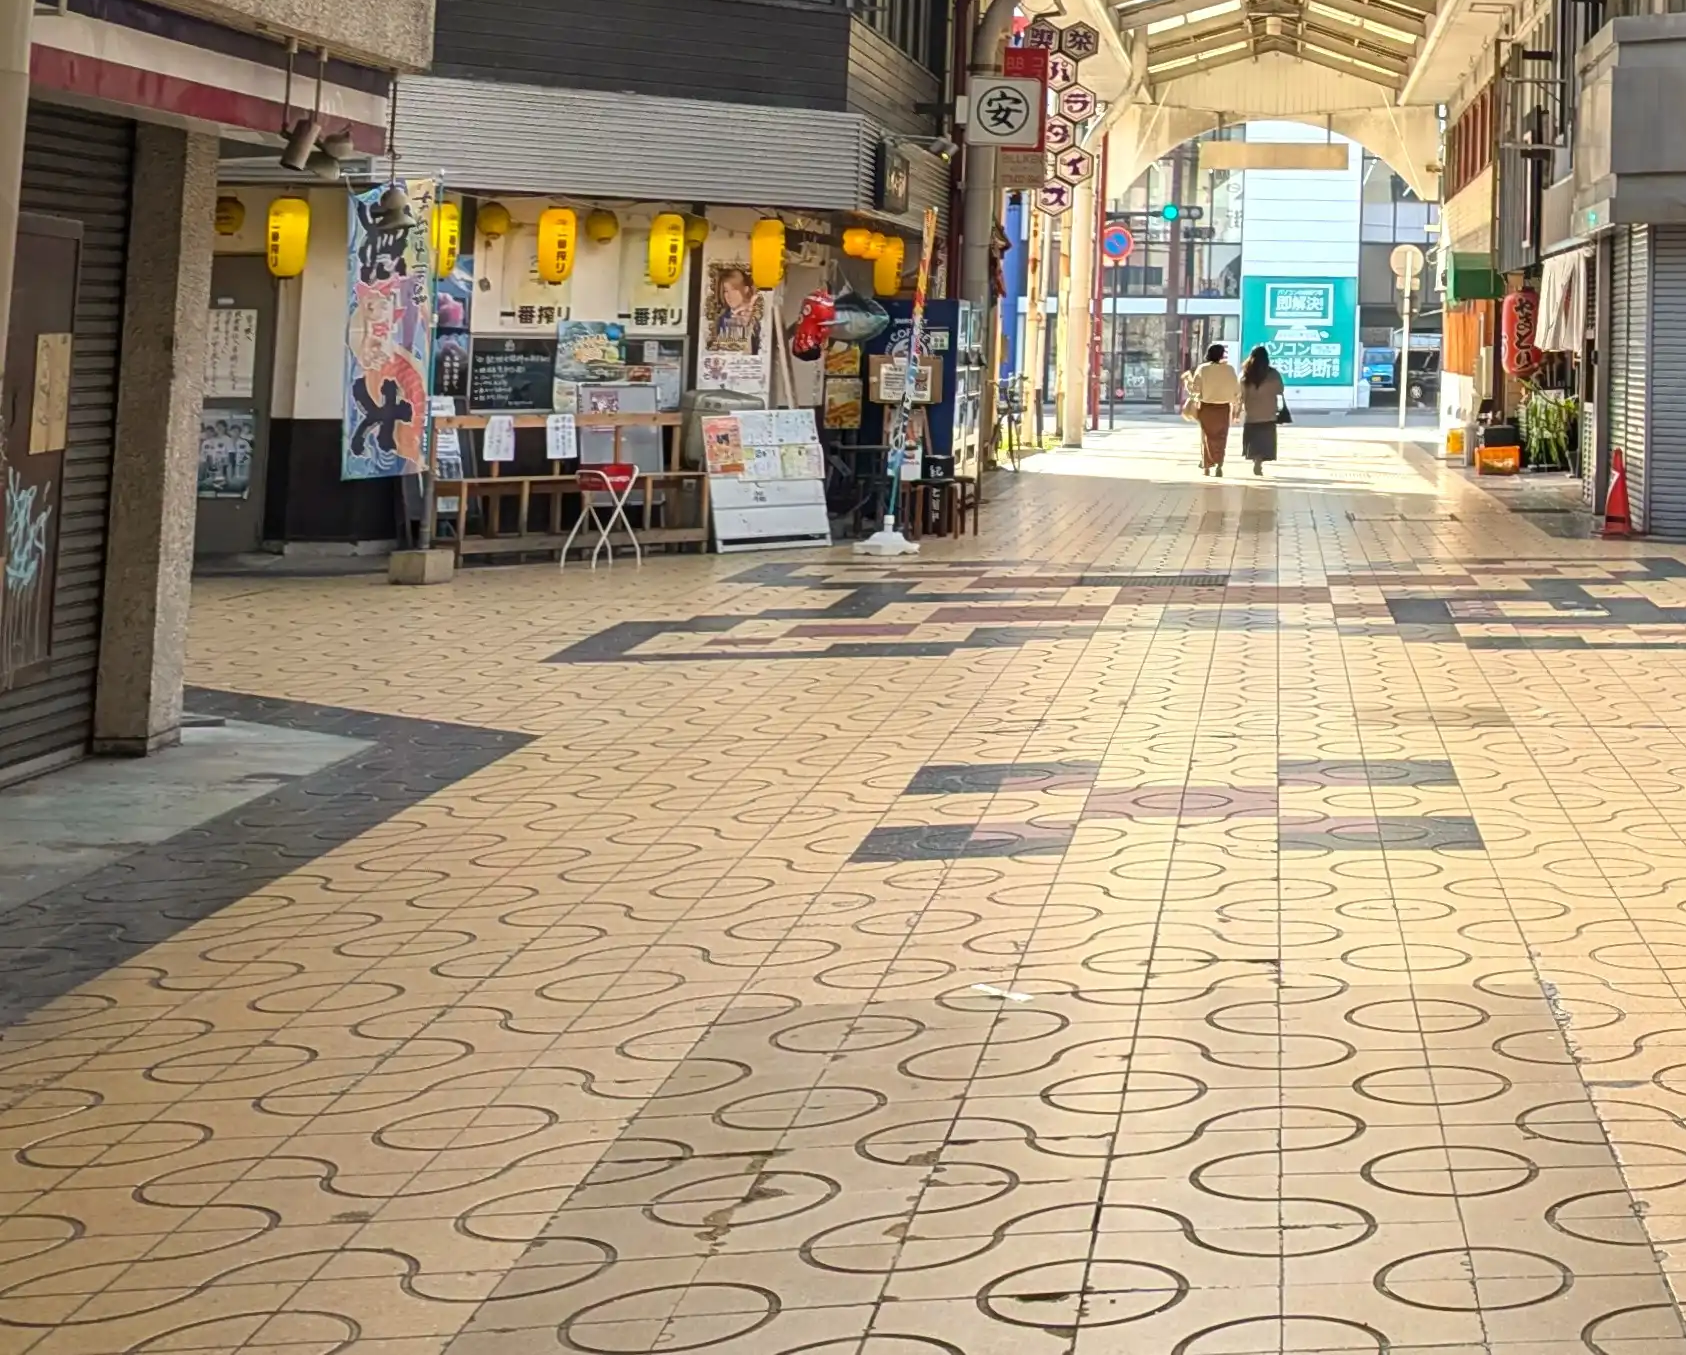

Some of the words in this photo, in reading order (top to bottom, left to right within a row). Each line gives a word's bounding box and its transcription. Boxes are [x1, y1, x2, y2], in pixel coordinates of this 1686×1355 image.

[984, 91, 1023, 129] 安
[500, 305, 571, 325] 一番搾り
[617, 307, 683, 326] 一番搾り
[1269, 357, 1330, 378] 料診断
